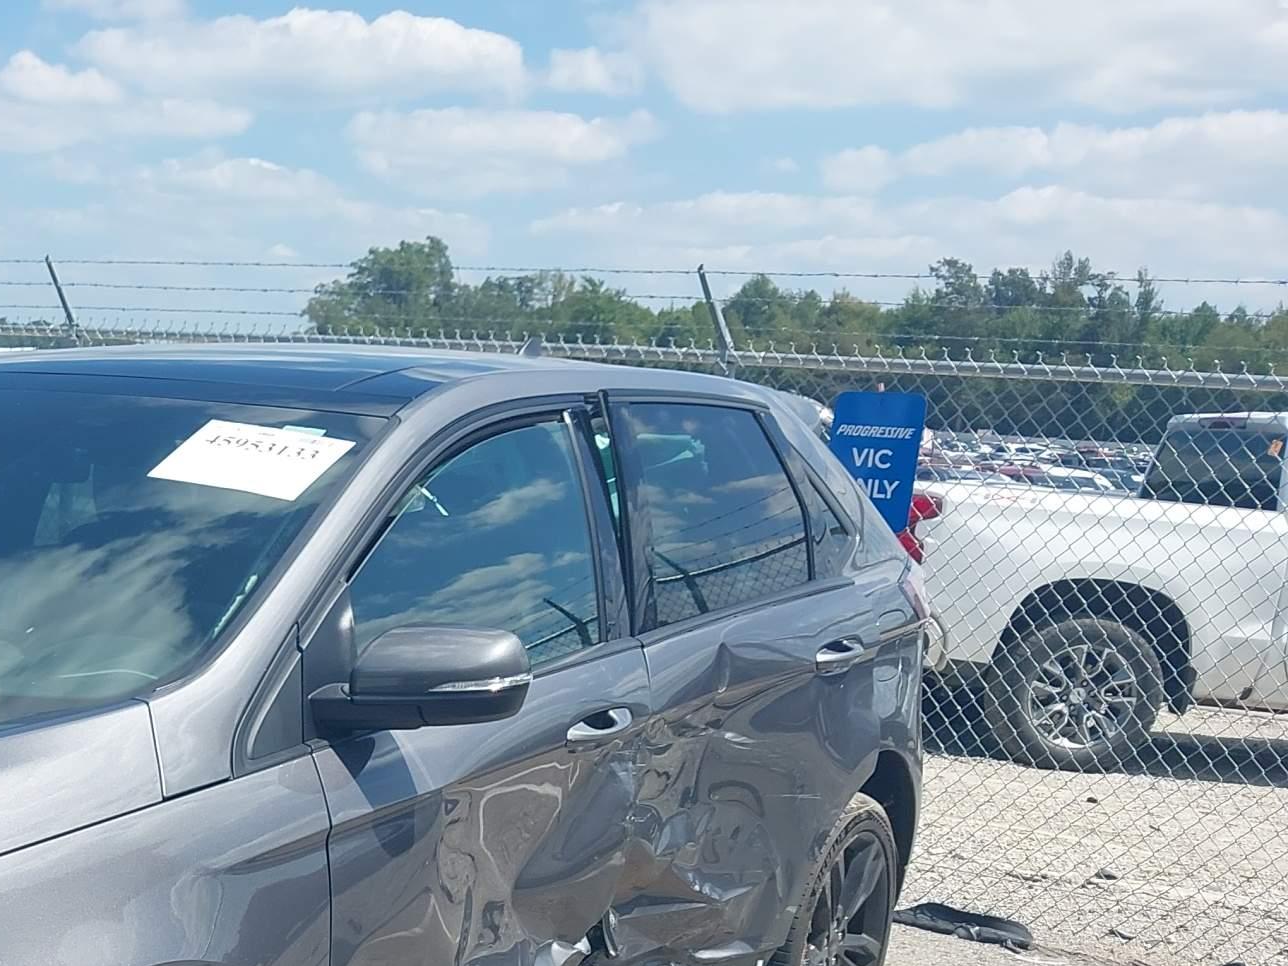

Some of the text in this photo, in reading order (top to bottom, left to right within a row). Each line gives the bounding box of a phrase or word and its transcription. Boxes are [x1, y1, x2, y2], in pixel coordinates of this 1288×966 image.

[836, 424, 916, 440] PROGRESSIVE
[852, 447, 893, 469] VIC
[857, 478, 901, 500] NLY
